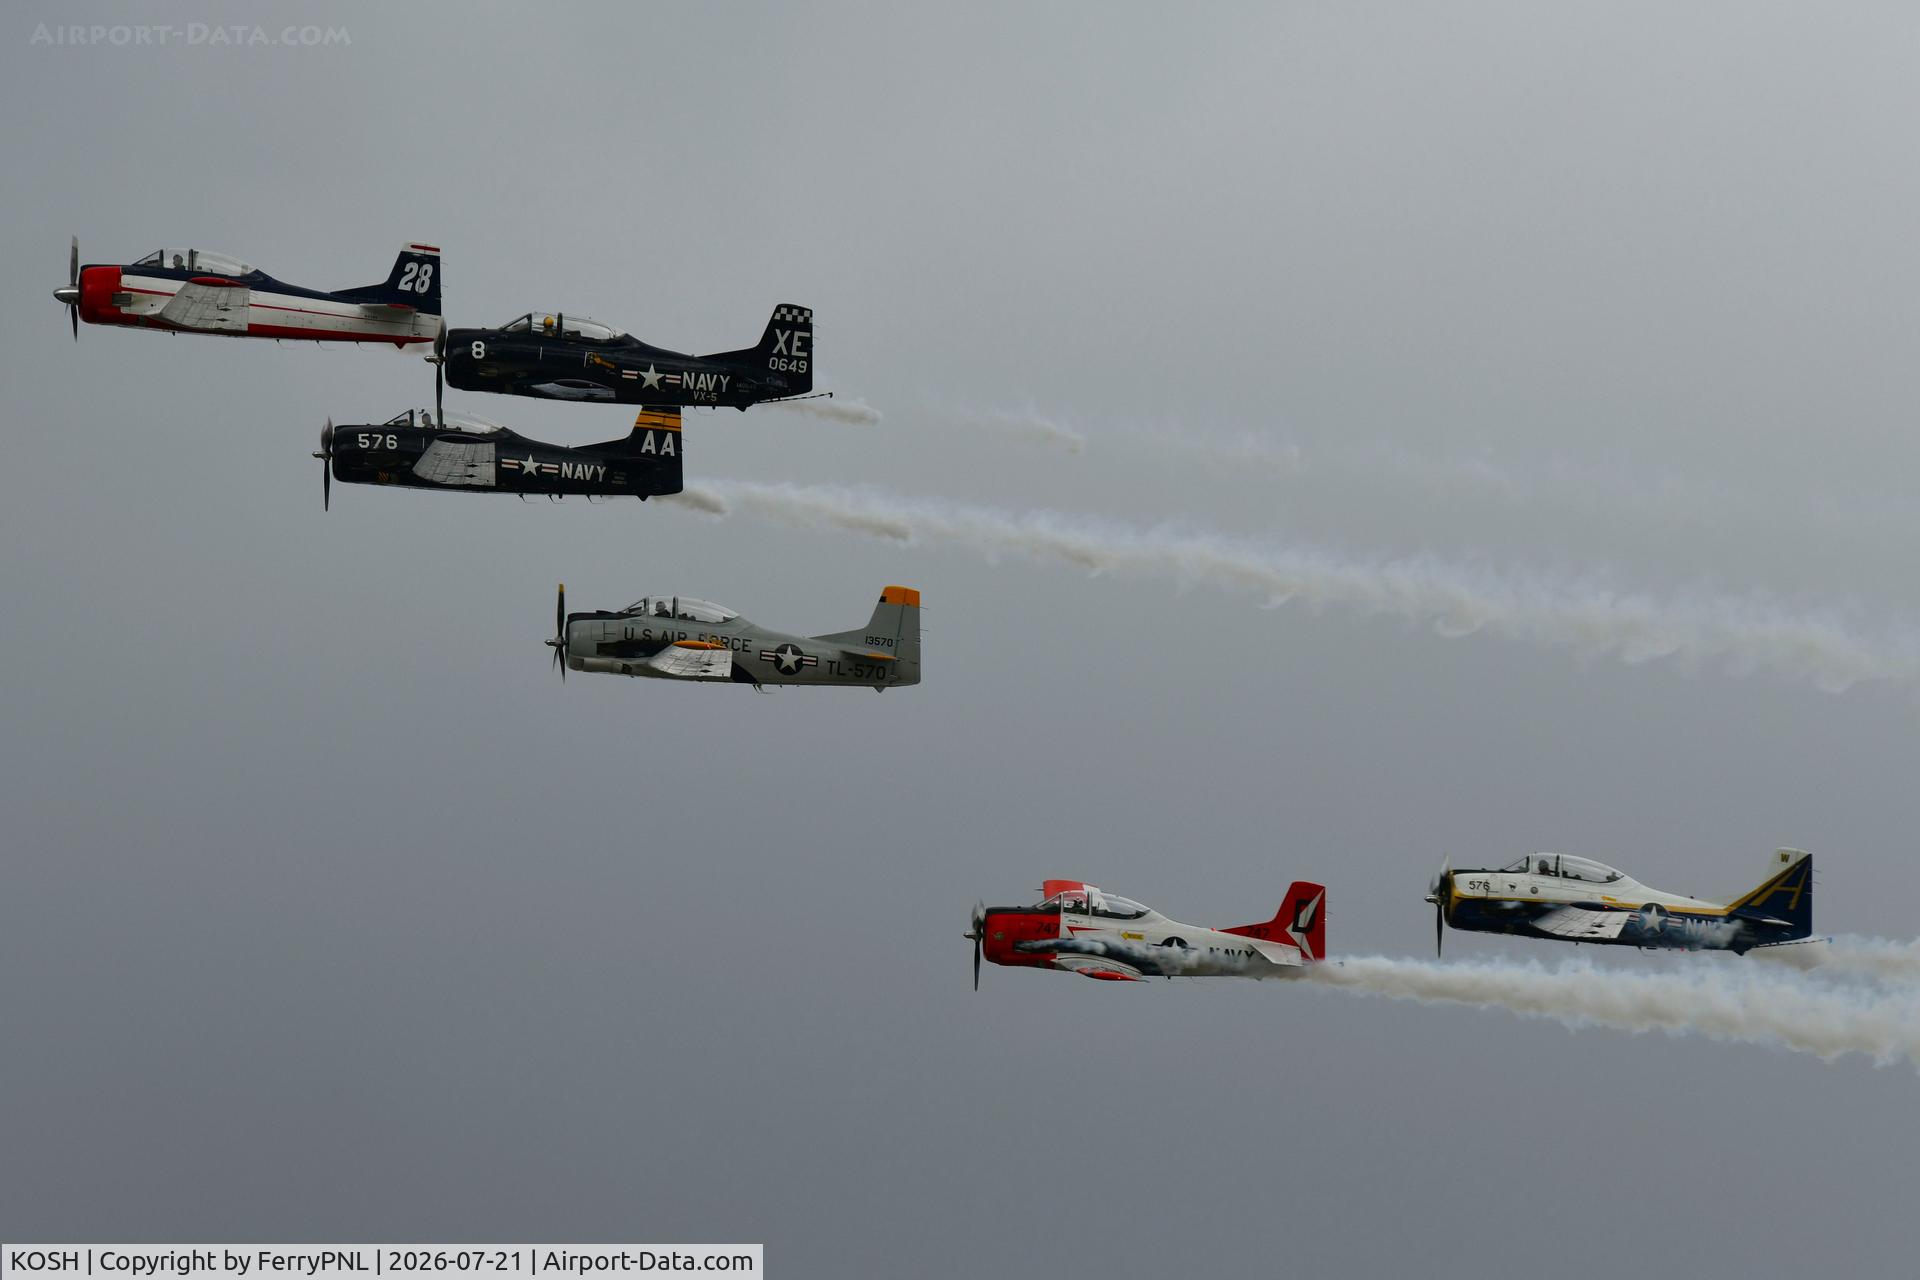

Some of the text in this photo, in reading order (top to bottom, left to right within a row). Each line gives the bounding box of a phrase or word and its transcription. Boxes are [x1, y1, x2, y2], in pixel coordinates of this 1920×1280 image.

[398, 262, 433, 293] 28
[472, 341, 485, 359] 8
[772, 329, 811, 357] XE
[769, 357, 808, 374] 0649
[682, 371, 731, 393] NAVY
[694, 392, 718, 402] VX-5
[358, 433, 398, 449] 576
[641, 430, 675, 457] AA
[561, 462, 607, 482] NAVY
[865, 636, 893, 647] 13570
[827, 660, 887, 680] TL-570
[1781, 853, 1790, 863] W
[1469, 881, 1490, 891] 576
[1035, 921, 1060, 935] 747
